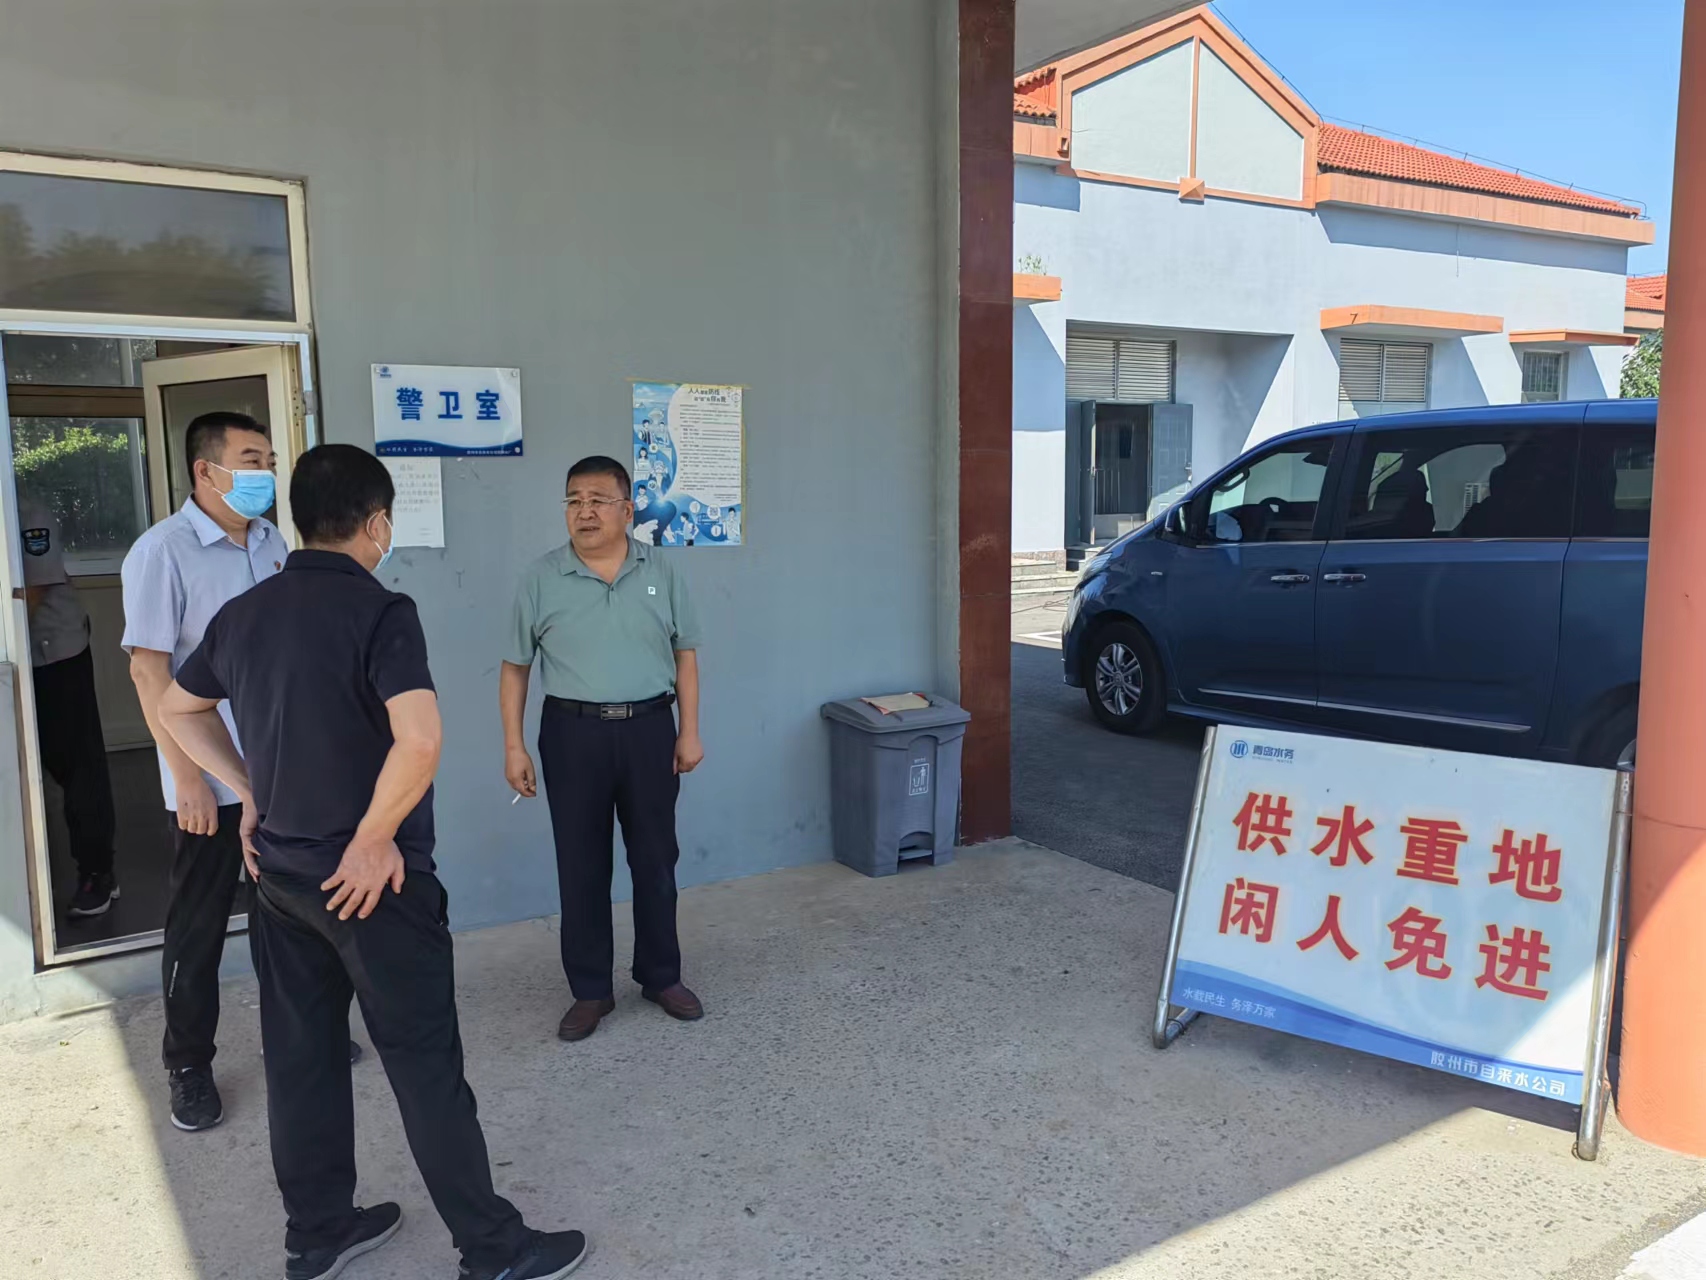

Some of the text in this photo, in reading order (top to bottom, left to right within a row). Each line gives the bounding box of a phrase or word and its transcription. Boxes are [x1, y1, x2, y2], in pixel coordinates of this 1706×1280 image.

[396, 387, 501, 421] 警卫室
[1252, 744, 1294, 760] 青岛水务
[1232, 791, 1564, 903] 供水重地
[1217, 877, 1552, 1002] 闲人免进
[1182, 986, 1277, 1019] 水载民生 务泽万家
[1430, 1050, 1566, 1097] 胶州市自来水公司
